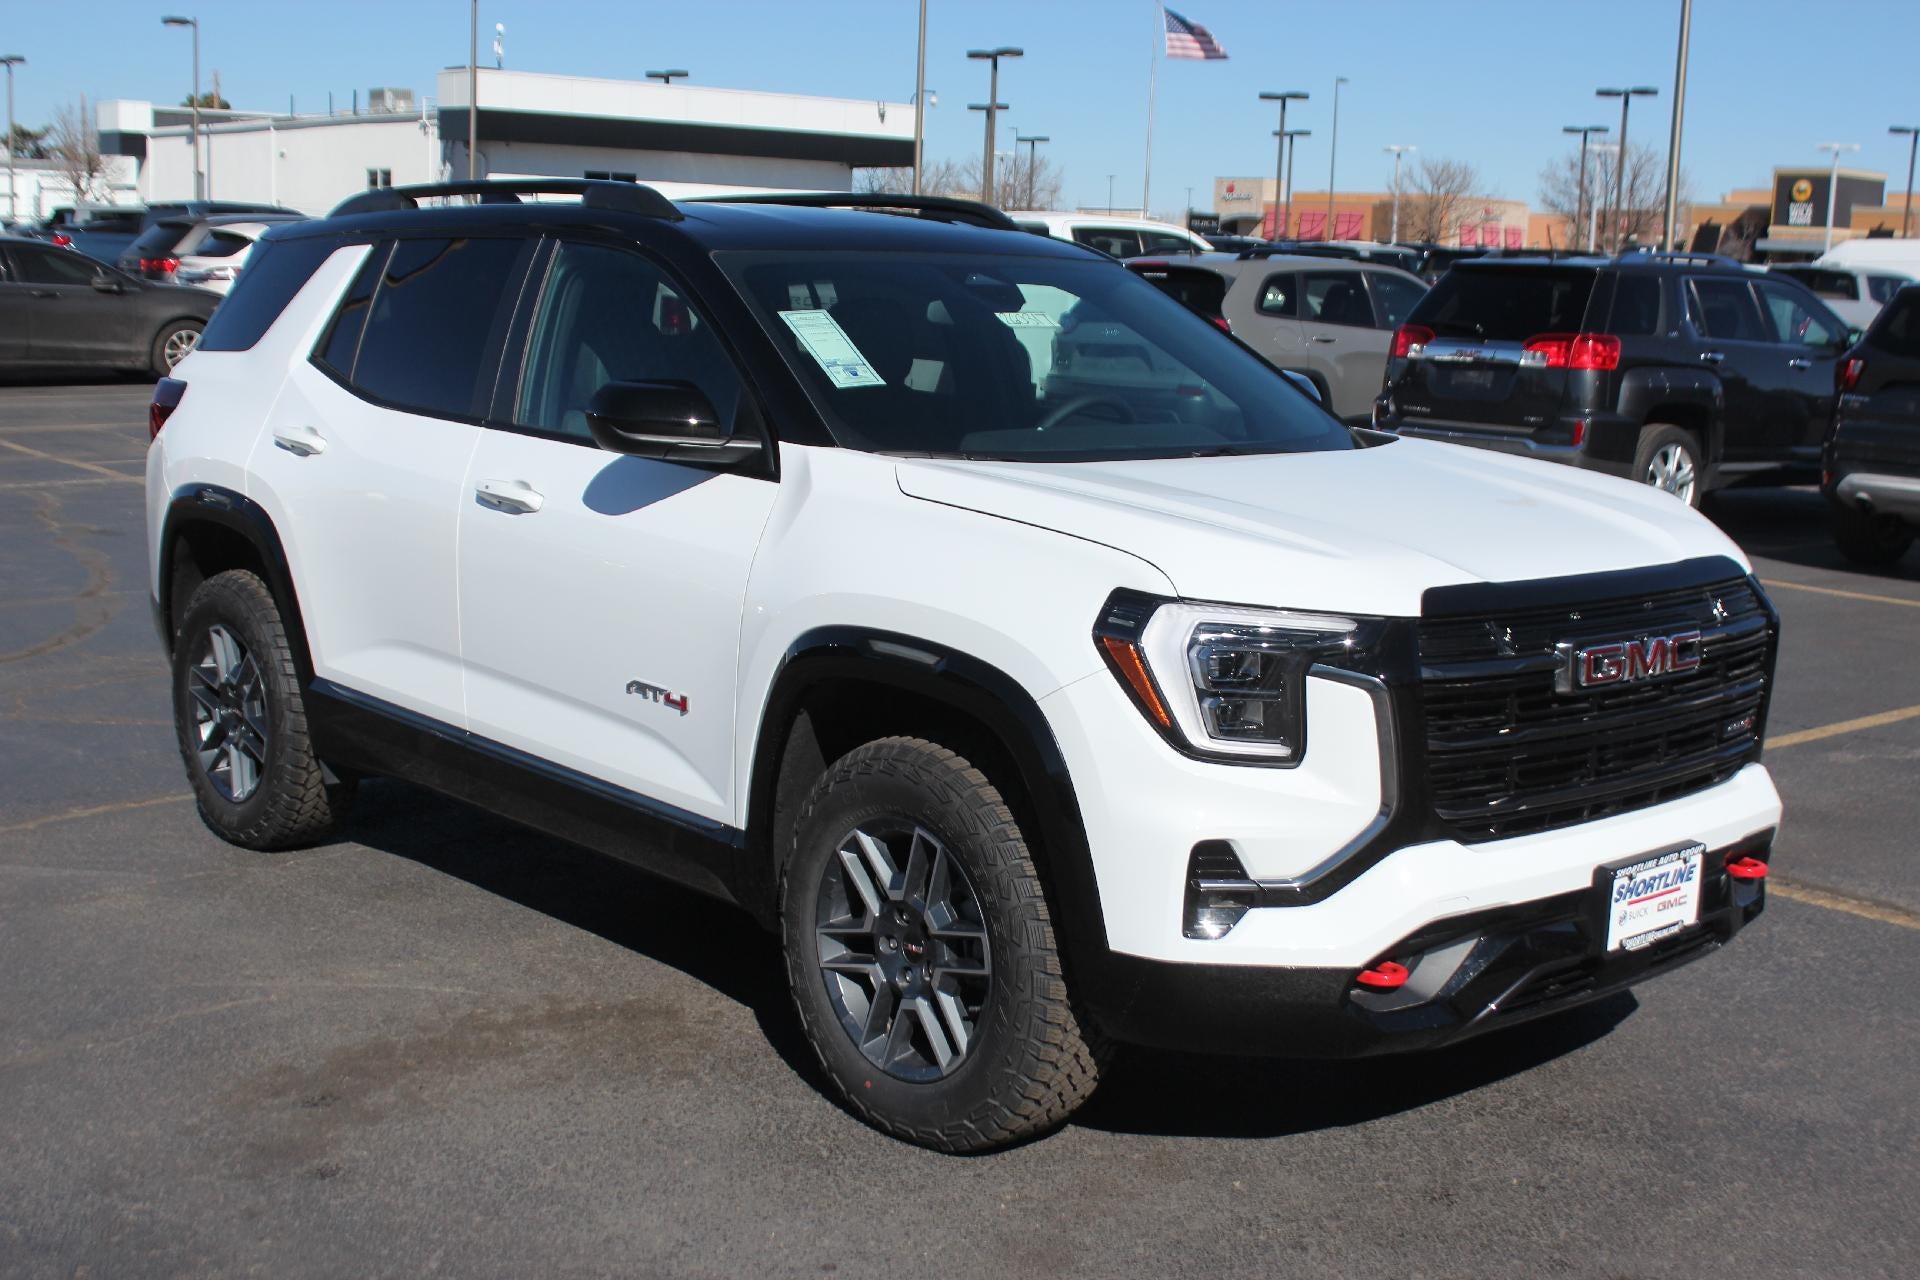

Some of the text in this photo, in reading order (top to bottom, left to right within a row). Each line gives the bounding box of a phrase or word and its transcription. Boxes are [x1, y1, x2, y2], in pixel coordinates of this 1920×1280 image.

[1579, 630, 1701, 686] GMC
[626, 678, 689, 716] AT4
[1615, 844, 1705, 879] SHORTLINE AUTO GROUP
[1614, 863, 1697, 903] SHORTLINE
[1656, 894, 1688, 911] GMC
